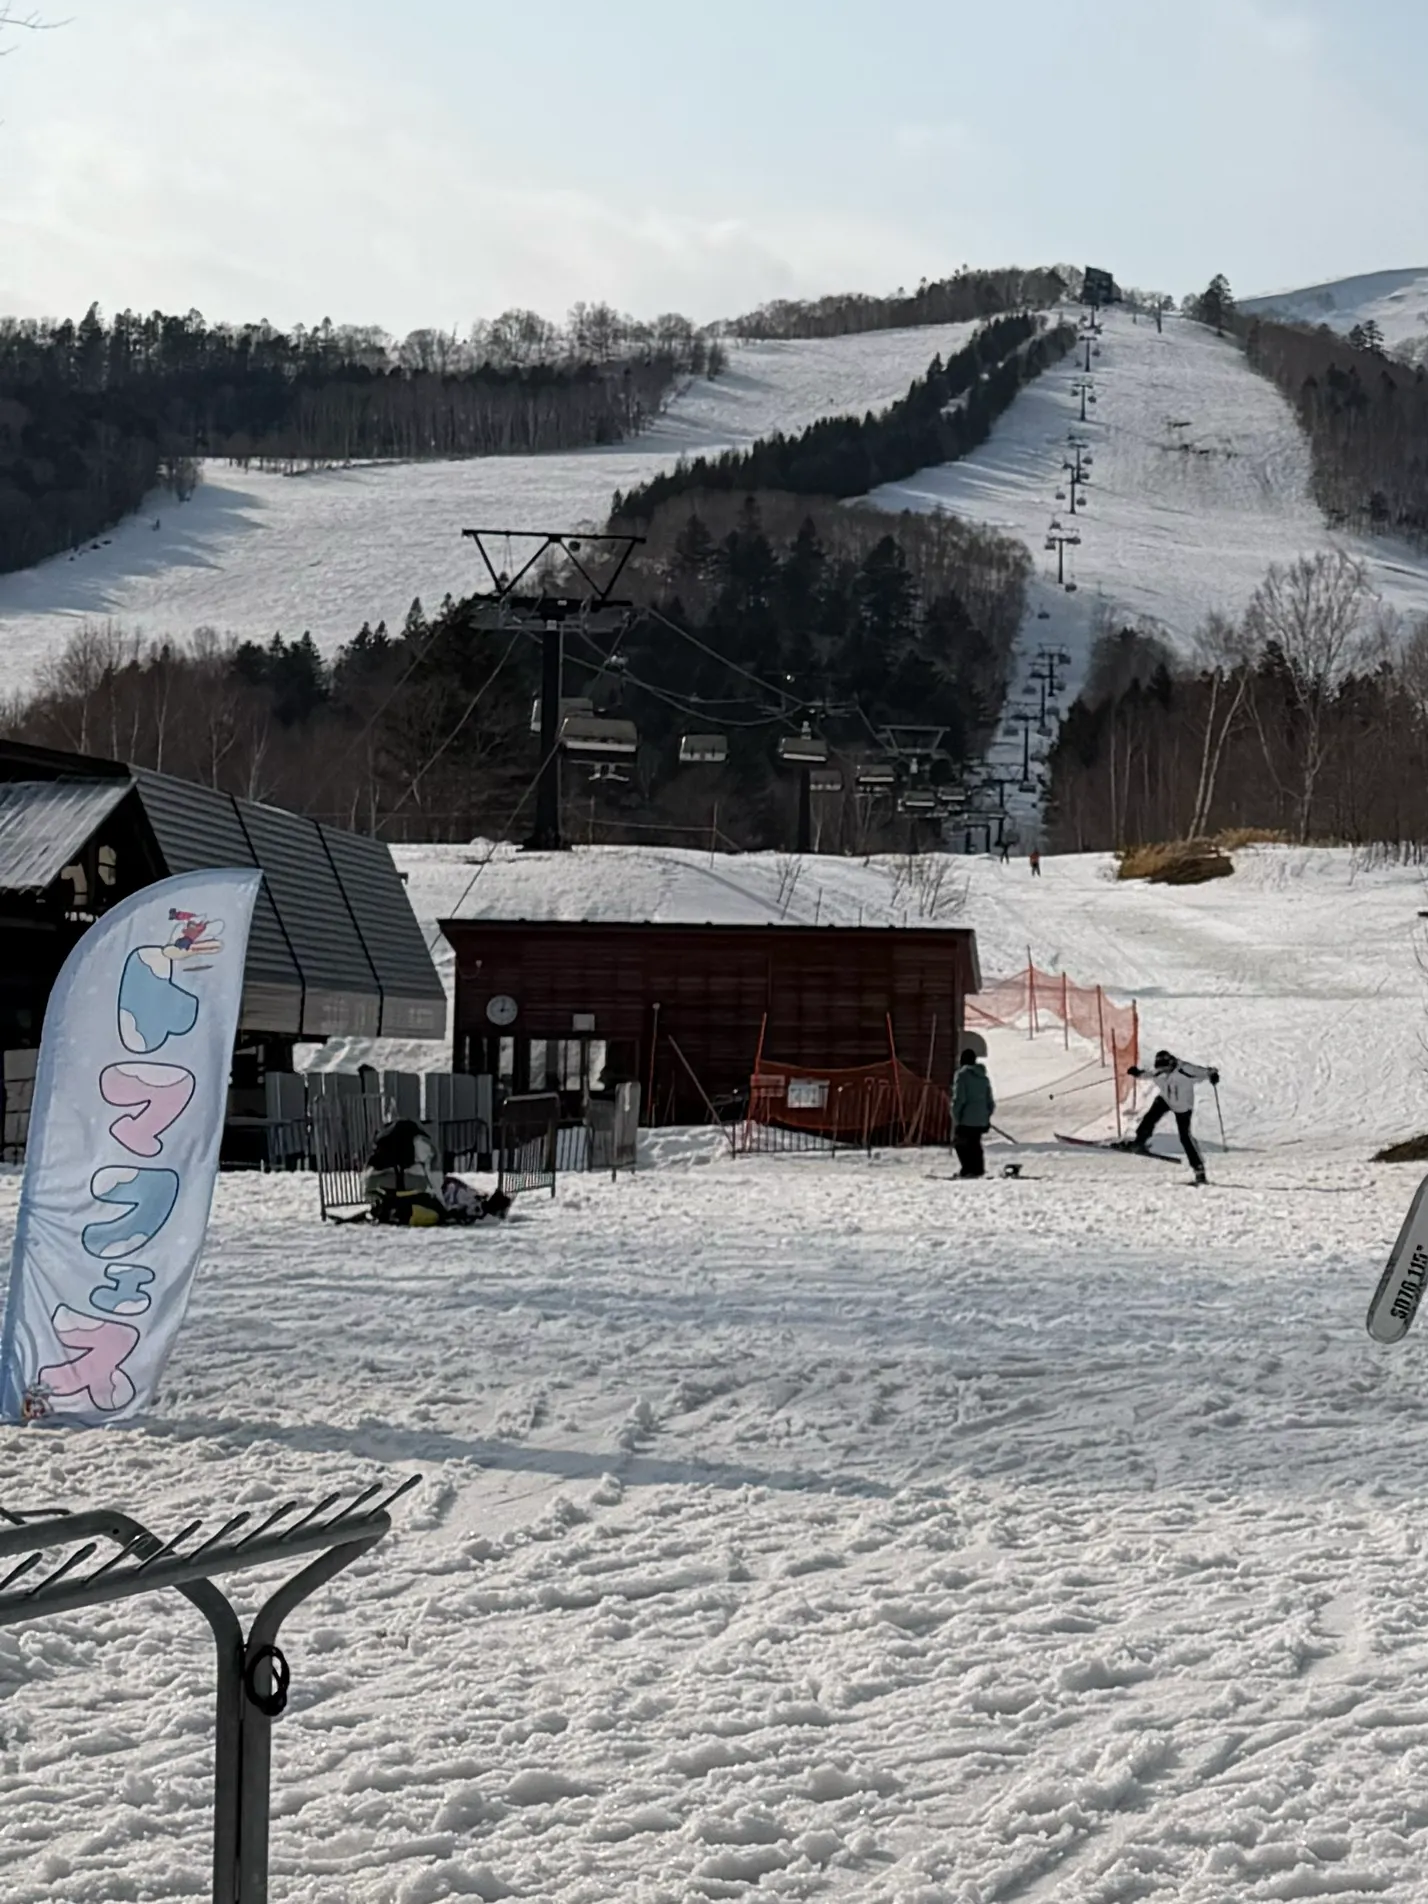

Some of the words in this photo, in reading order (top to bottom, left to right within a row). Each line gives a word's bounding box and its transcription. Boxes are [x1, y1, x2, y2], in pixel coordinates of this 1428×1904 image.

[38, 945, 199, 1413] トマフェス
